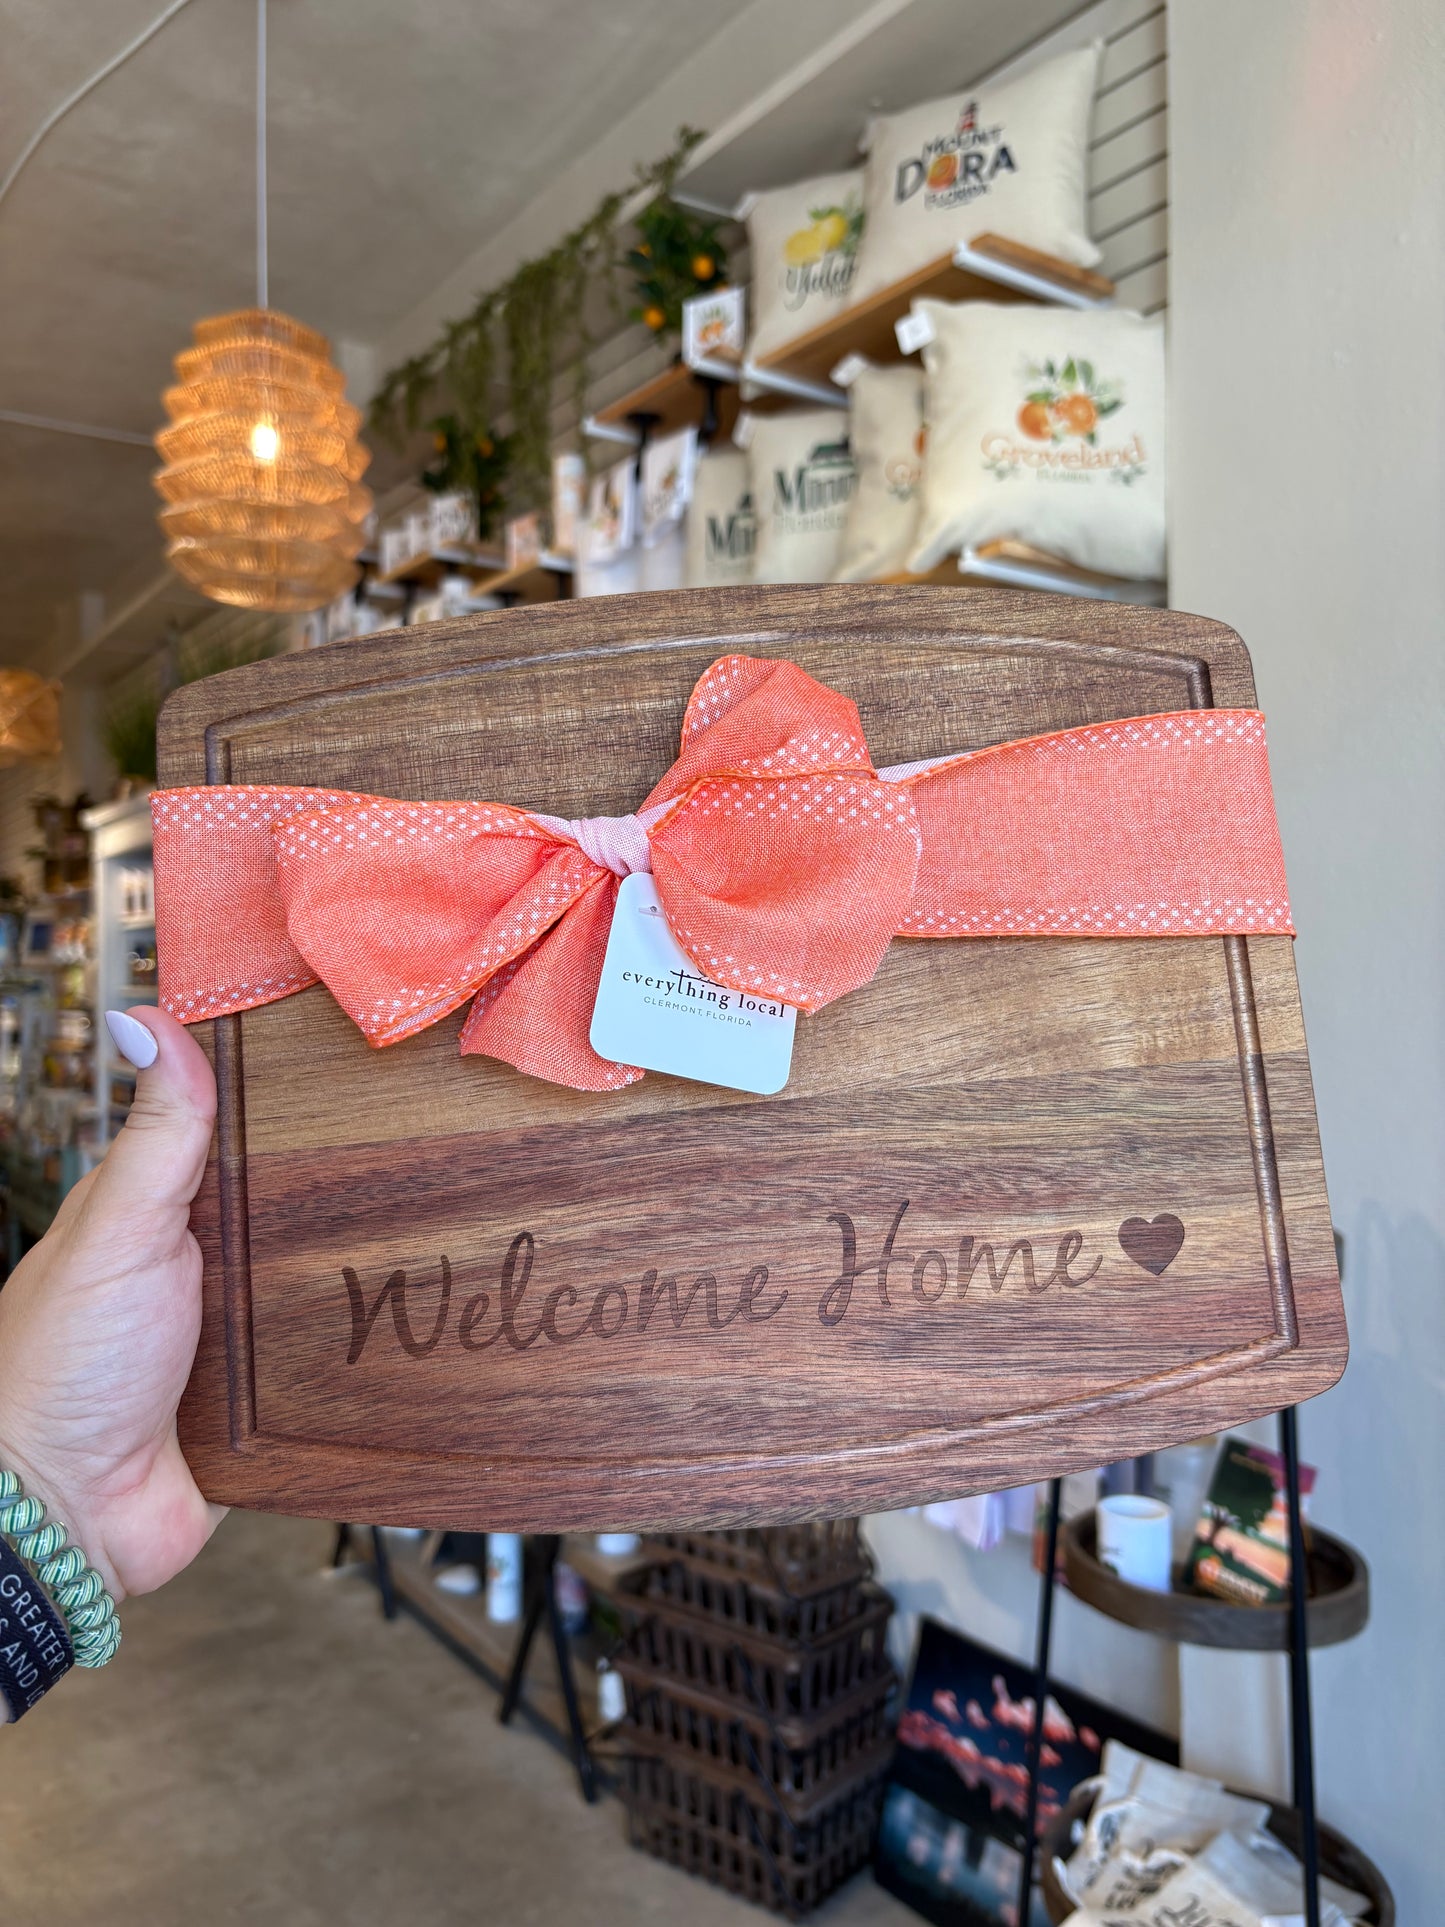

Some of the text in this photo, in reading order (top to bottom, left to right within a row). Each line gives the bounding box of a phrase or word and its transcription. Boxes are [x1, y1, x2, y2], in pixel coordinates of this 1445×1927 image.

[894, 145, 1018, 204] DORA
[622, 969, 785, 1017] everything local
[705, 1011, 752, 1027] FLORIDA
[341, 1199, 1104, 1365] Welcome Home
[0, 1574, 66, 1669] GREATER
[1, 1641, 39, 1688] AND
